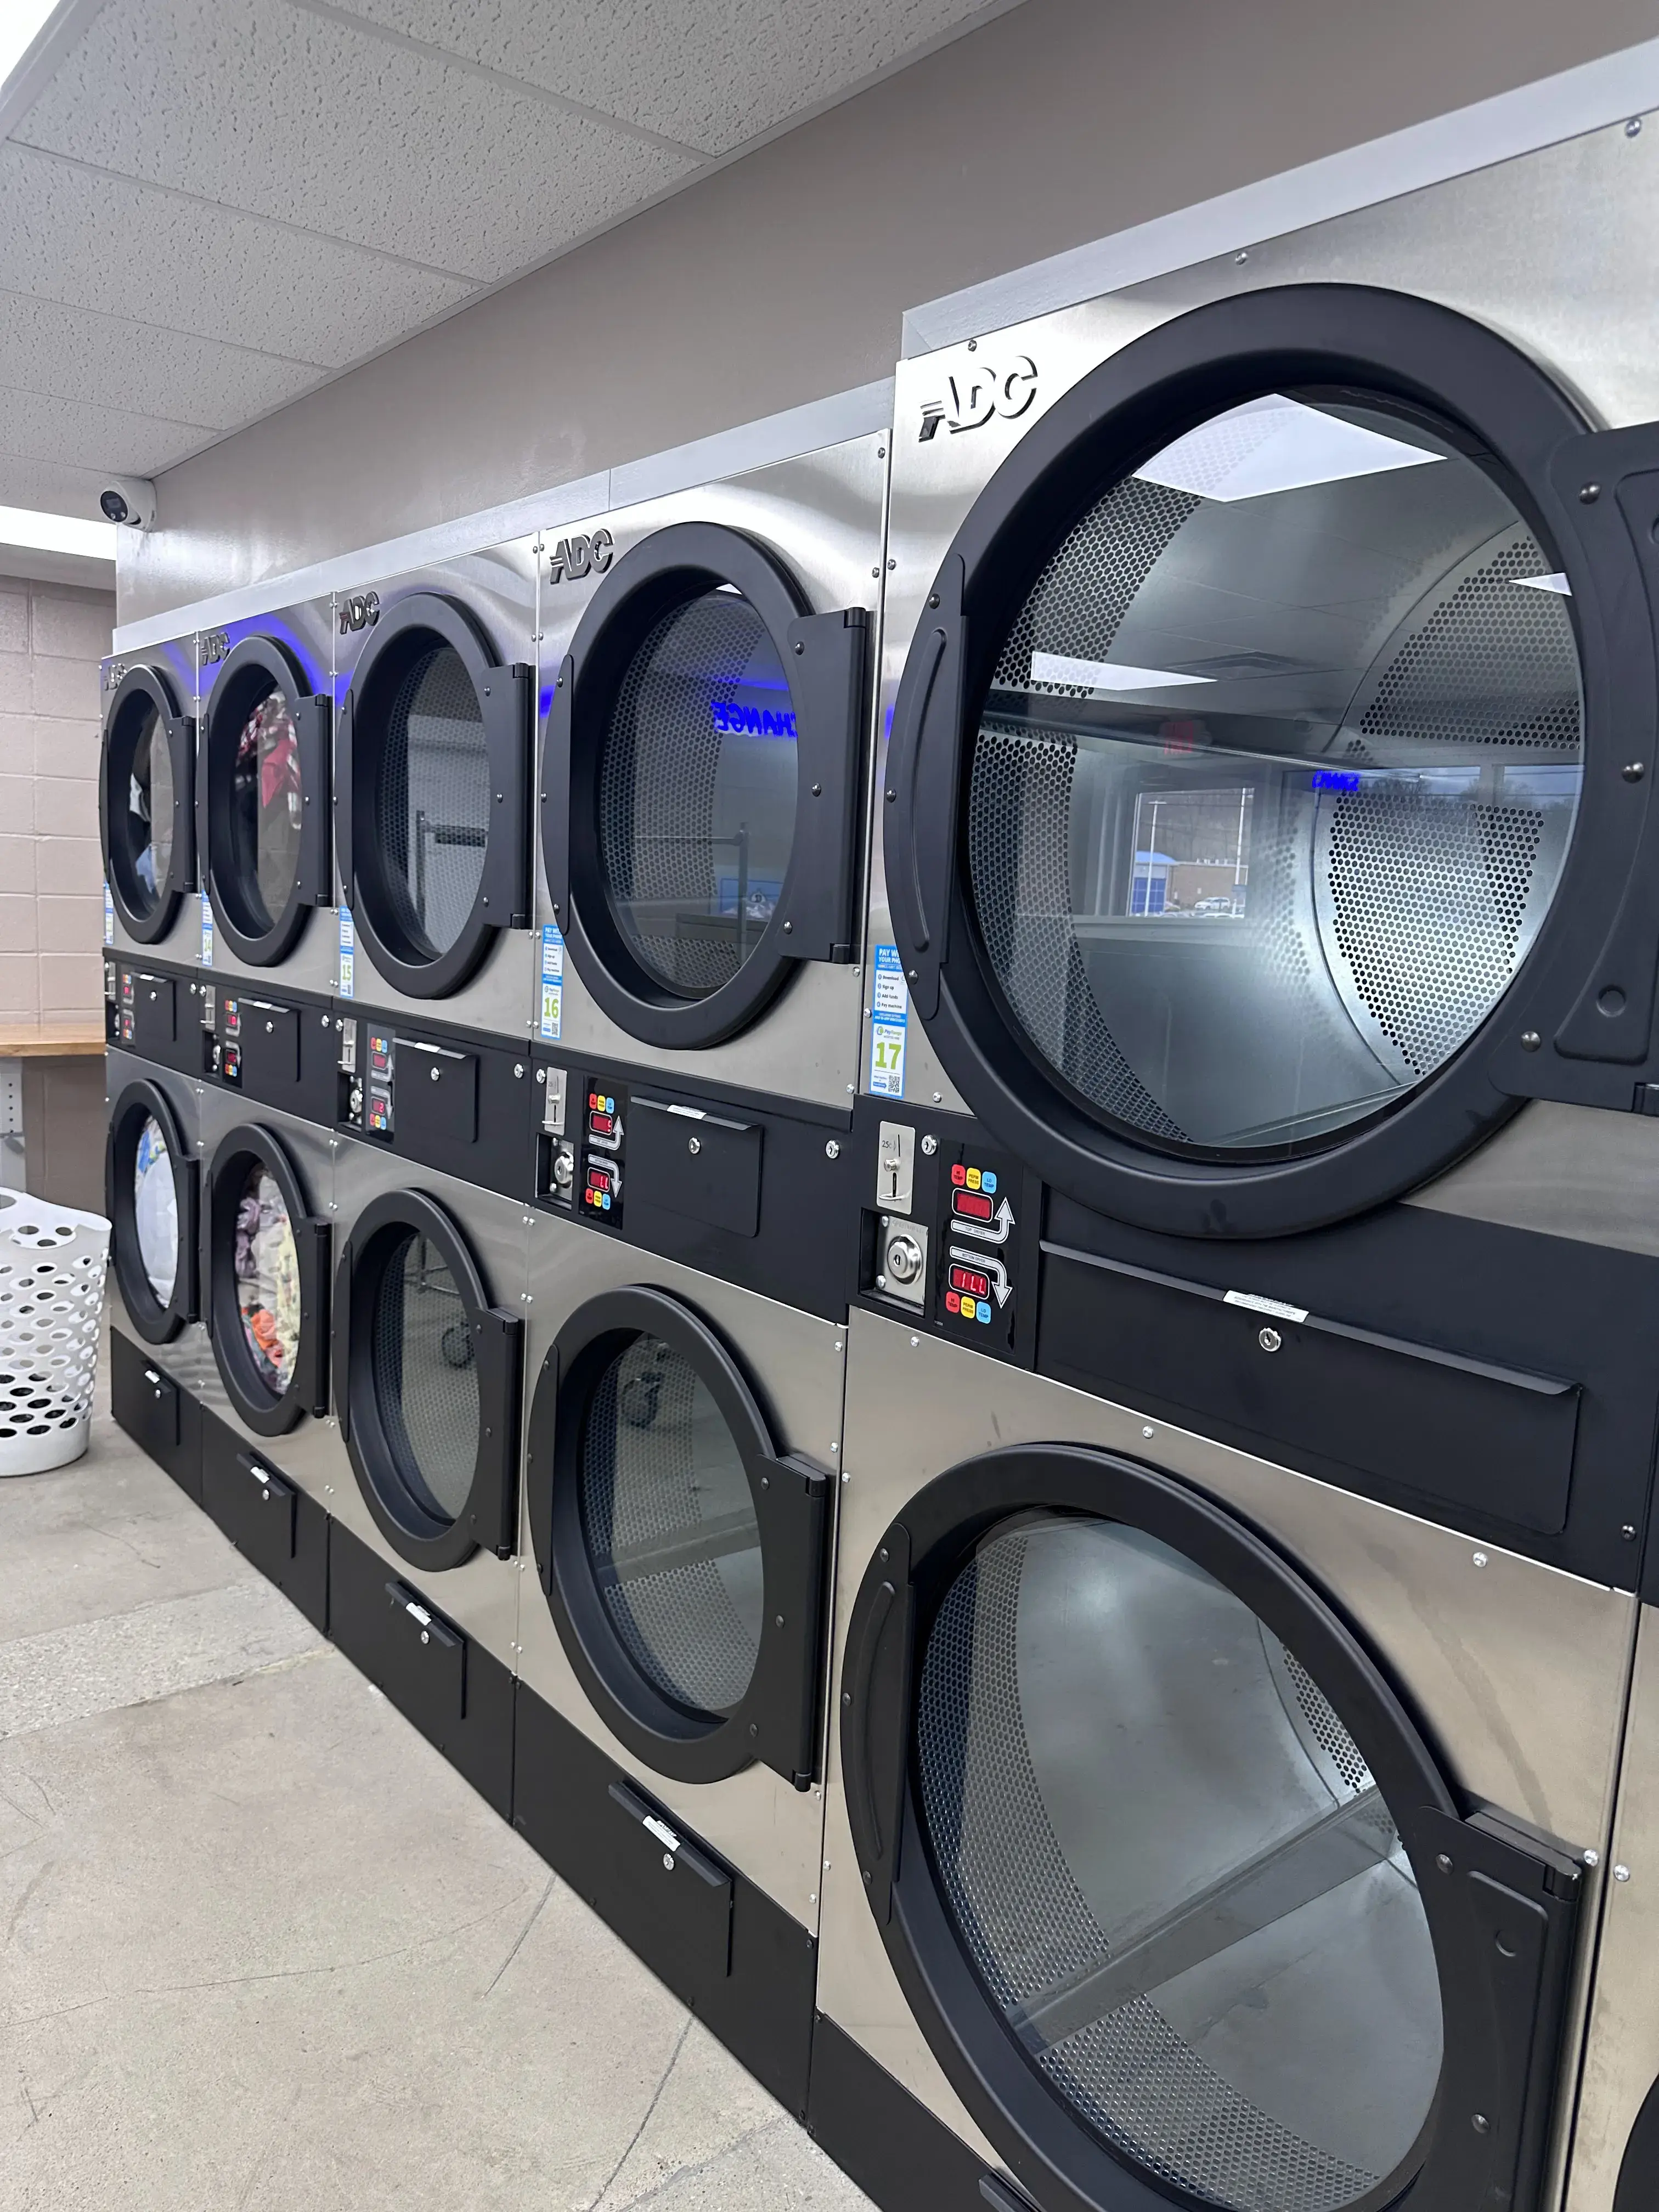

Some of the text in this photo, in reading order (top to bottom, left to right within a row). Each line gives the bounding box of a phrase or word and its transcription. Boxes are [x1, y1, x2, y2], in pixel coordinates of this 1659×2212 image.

[916, 356, 1038, 442] ADC
[550, 528, 613, 585] ADC
[339, 591, 380, 635] ADC
[201, 631, 230, 666] ADC
[879, 948, 890, 957] PAY
[342, 964, 352, 981] 15
[544, 997, 558, 1019] 16
[876, 1042, 902, 1070] 17
